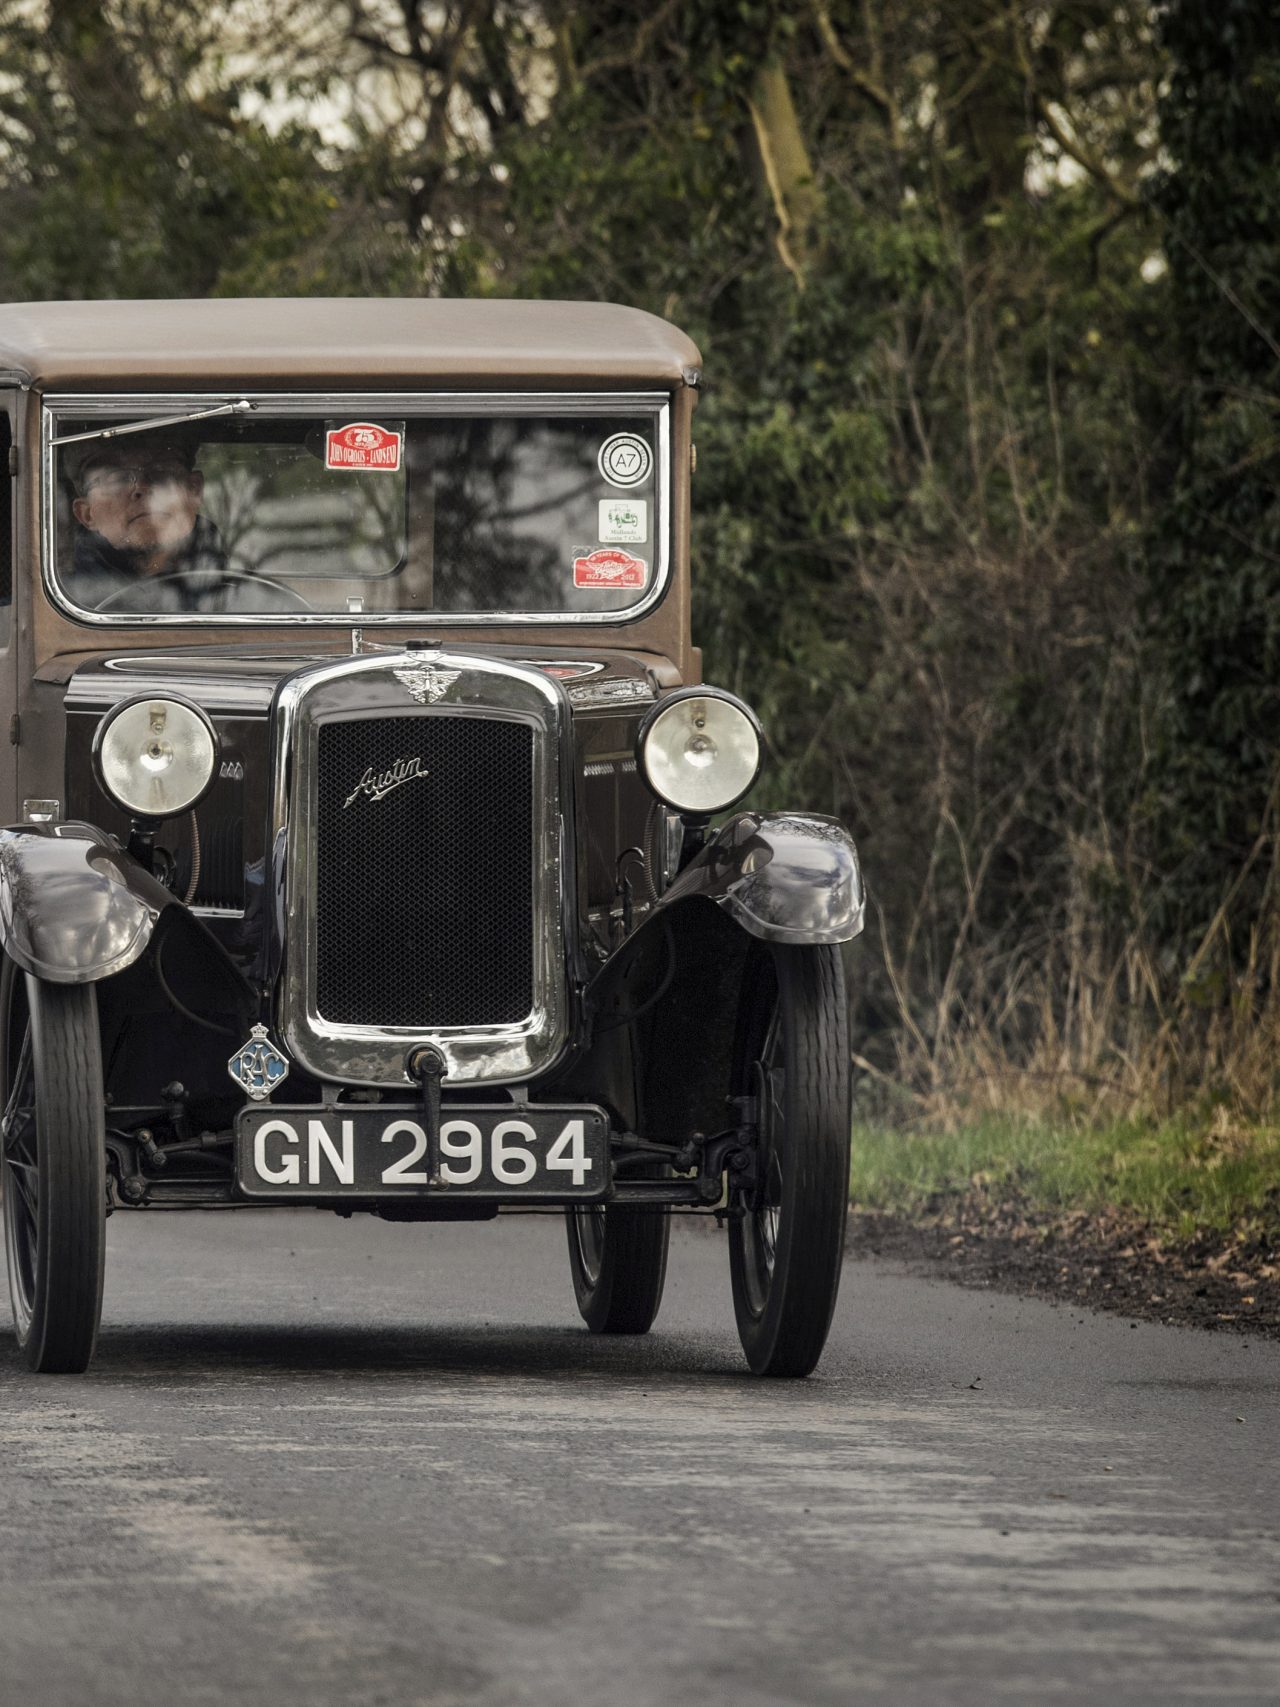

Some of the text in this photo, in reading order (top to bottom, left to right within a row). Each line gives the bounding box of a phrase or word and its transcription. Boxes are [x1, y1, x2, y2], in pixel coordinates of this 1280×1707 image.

[353, 429, 375, 443] 75
[615, 453, 636, 468] A7
[343, 755, 429, 809] Austin
[239, 1044, 280, 1089] RAC
[253, 1119, 593, 1185] GN 2964
